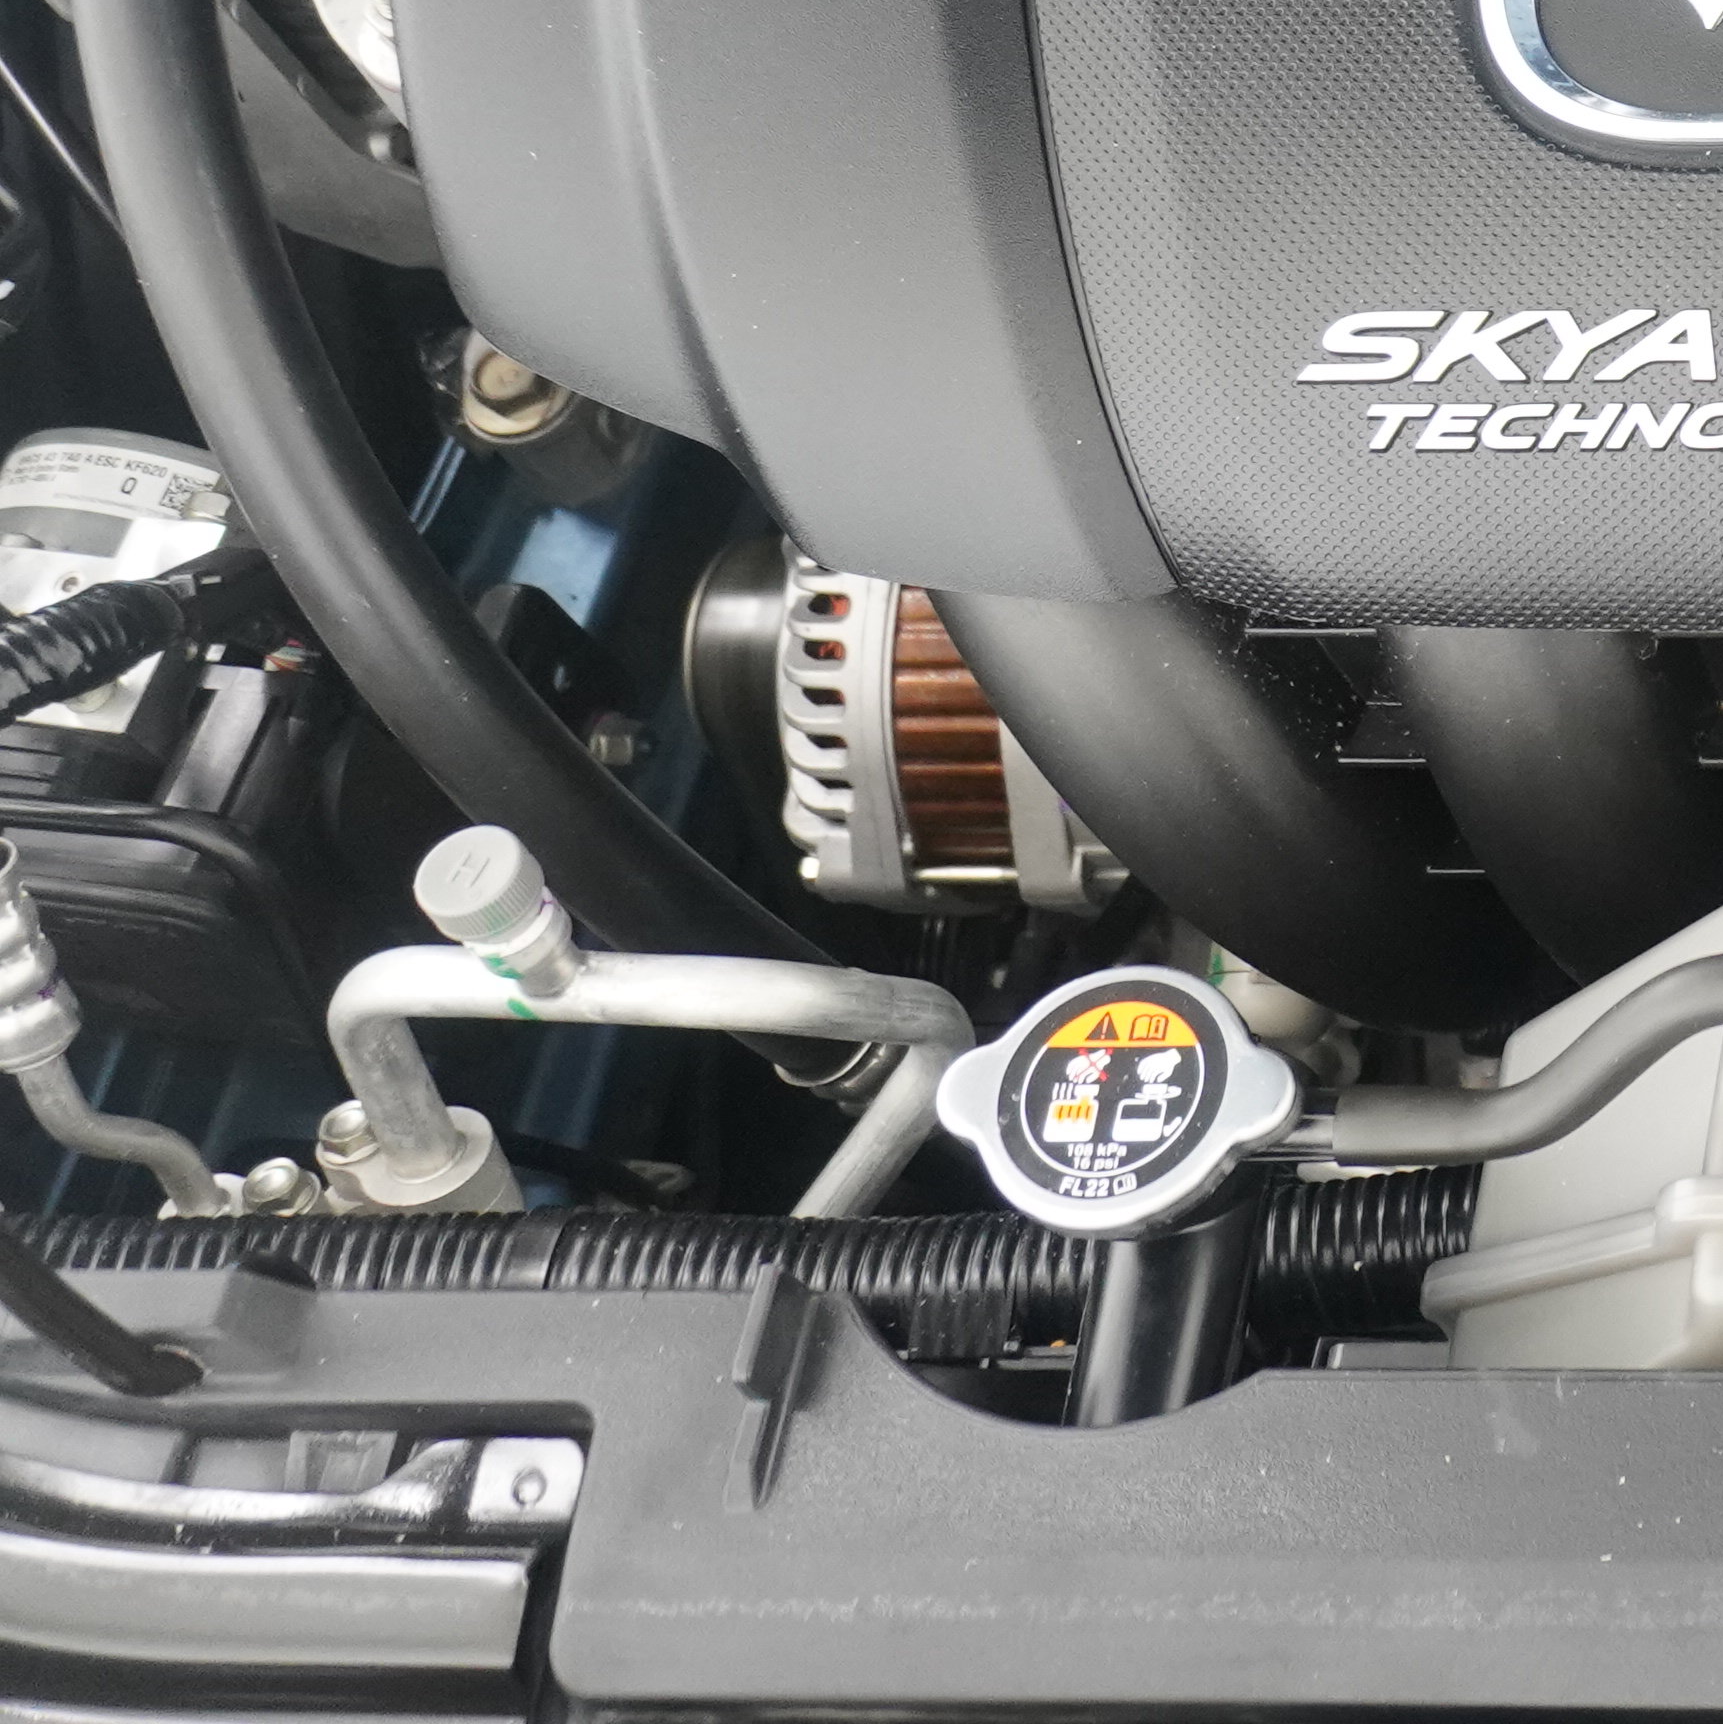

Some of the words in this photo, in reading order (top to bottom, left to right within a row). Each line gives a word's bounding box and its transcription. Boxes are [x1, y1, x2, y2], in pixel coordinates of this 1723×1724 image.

[1096, 1142, 1128, 1157] kPa
[1073, 1156, 1092, 1171] 16
[1093, 1156, 1120, 1173] psi
[1058, 1175, 1111, 1198] FL22
